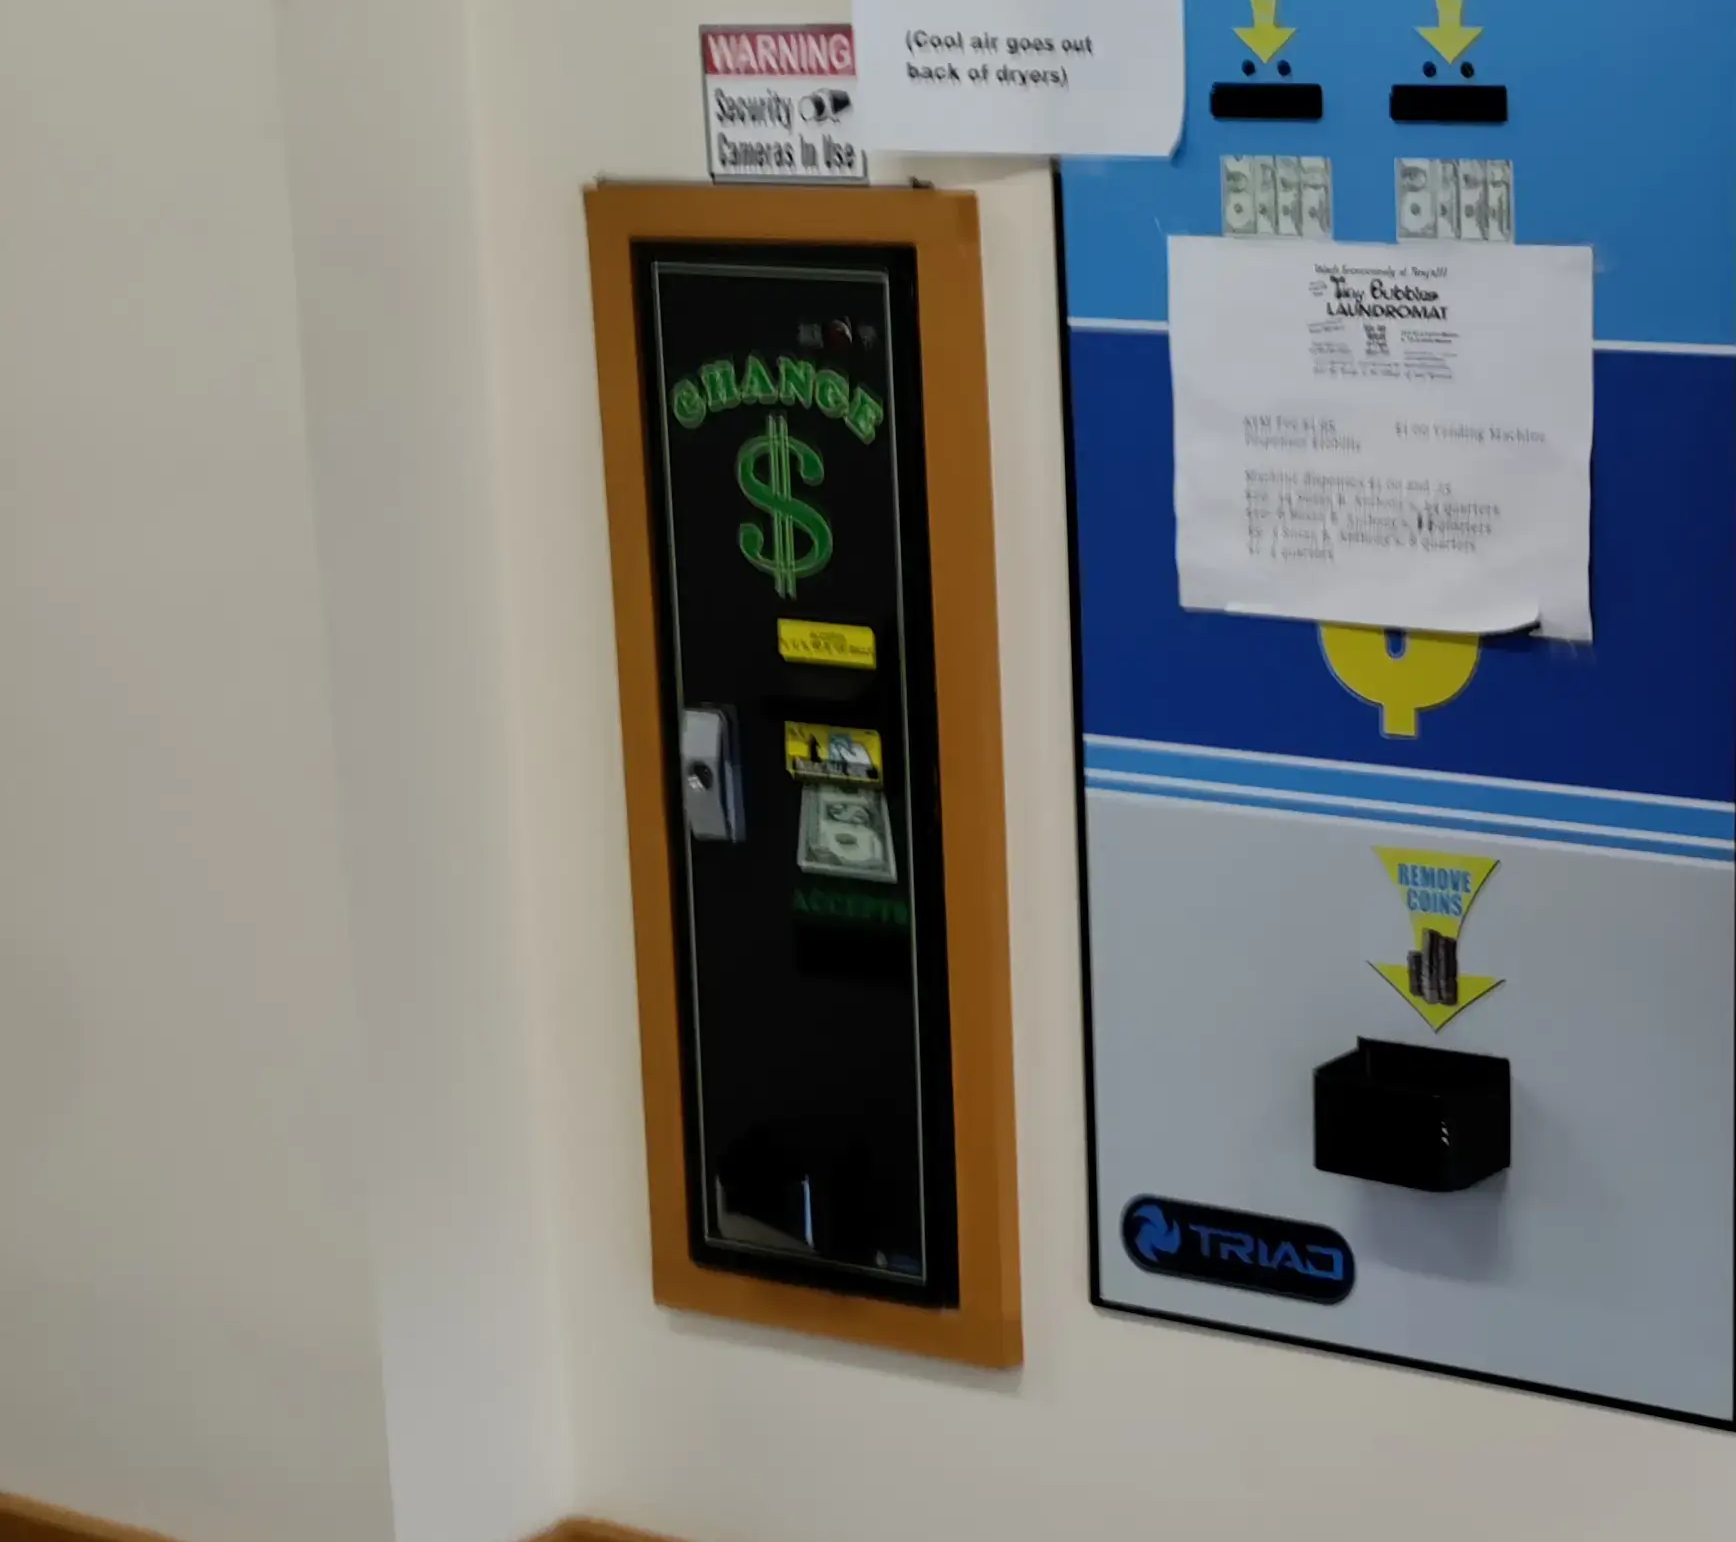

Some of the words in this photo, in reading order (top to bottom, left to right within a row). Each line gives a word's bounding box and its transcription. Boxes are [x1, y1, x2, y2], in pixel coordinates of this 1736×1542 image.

[708, 34, 853, 73] WARNING
[906, 29, 964, 57] (Cool
[970, 32, 999, 54] air
[1007, 36, 1054, 56] goes
[1061, 35, 1093, 56] out
[907, 62, 960, 84] back
[967, 64, 990, 83] of
[996, 65, 1068, 89] dryers)
[714, 87, 793, 132] Security
[717, 132, 796, 168] Cameras
[800, 132, 819, 168] In
[823, 134, 856, 168] Use
[1329, 275, 1364, 302] Tiny
[1370, 278, 1439, 302] Bubbles
[1326, 303, 1448, 320] LAUNDROMAT
[668, 355, 884, 445] CHANGE
[1398, 862, 1472, 893] REMOVE
[1406, 888, 1464, 916] COINS
[1189, 1223, 1344, 1281] TRIAD
